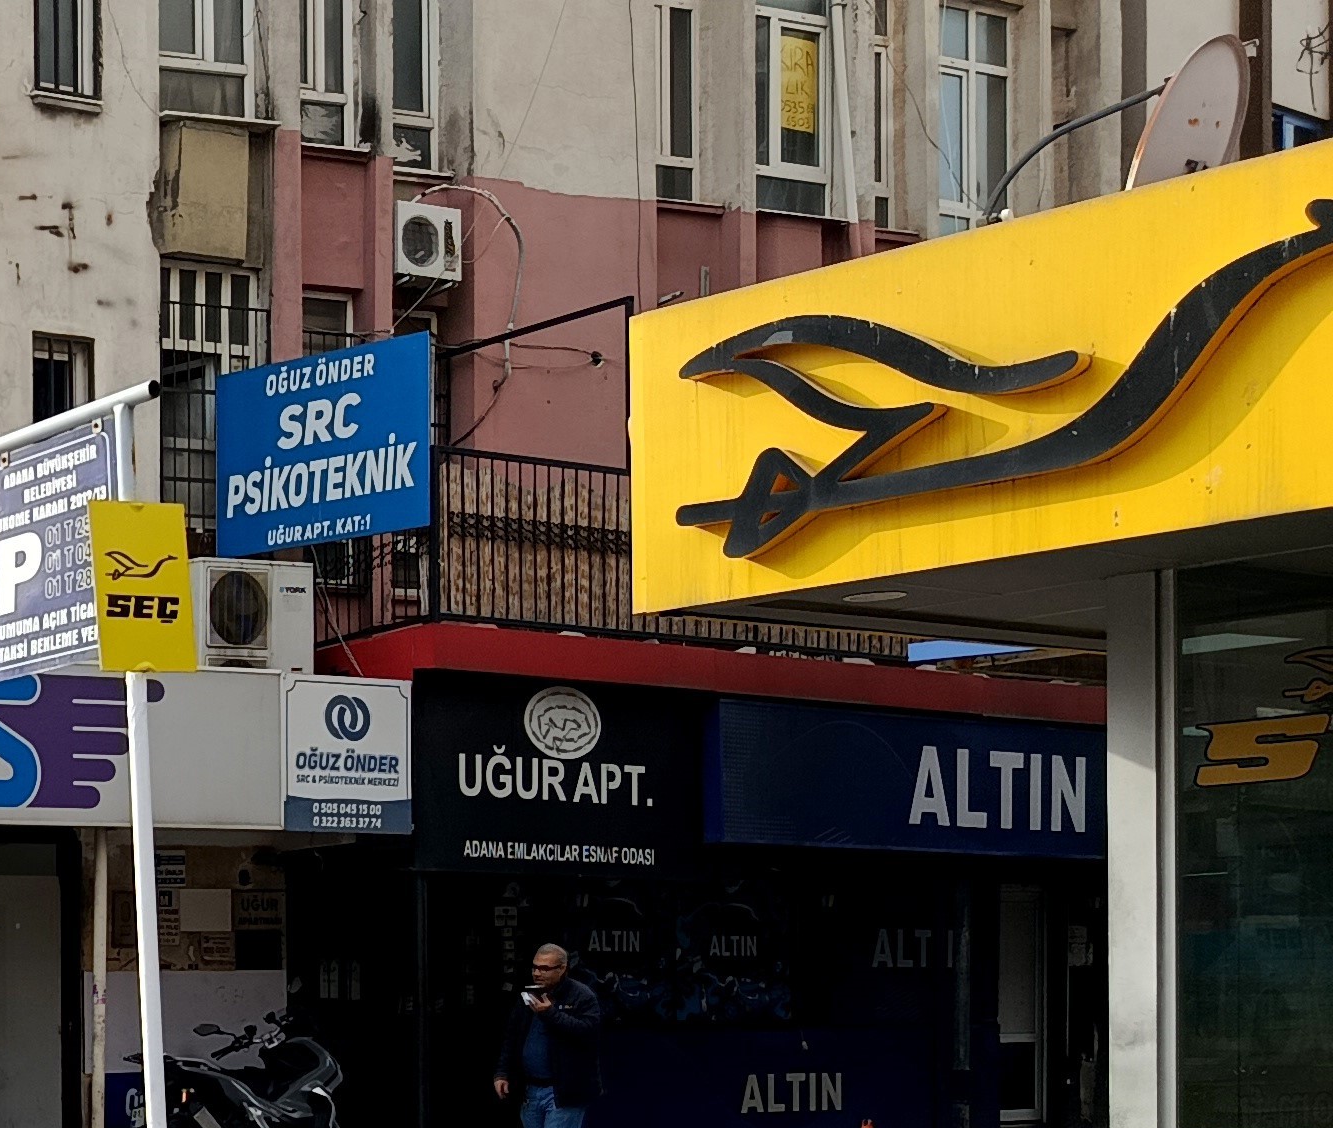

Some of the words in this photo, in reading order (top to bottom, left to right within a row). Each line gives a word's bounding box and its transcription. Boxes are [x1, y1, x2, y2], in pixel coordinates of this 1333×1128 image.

[265, 366, 312, 397] OĞUZ
[315, 353, 375, 386] ÖNDER
[277, 392, 361, 450] SRC
[3, 466, 35, 490] ADANA
[37, 444, 97, 479] BÜYÜKŞEHİR
[226, 432, 417, 519] PSİKOTEKNİK
[23, 470, 77, 504] BELEDİYESİ
[33, 498, 68, 522] KARARI
[44, 523, 61, 547] 01
[64, 519, 74, 541] T
[267, 524, 302, 545] UĞUR
[303, 520, 333, 541] APT.
[336, 514, 371, 535] KAT:1
[44, 549, 61, 573] 01
[64, 545, 74, 568] T
[44, 575, 61, 599] 01
[64, 571, 74, 594] T
[0, 616, 40, 641] UMUMA
[43, 608, 68, 630] AÇIK
[70, 602, 94, 622] TİCA
[105, 593, 179, 623] SEÇ
[0, 638, 27, 664] TAKSİ
[31, 629, 78, 656] BEKLEME
[296, 747, 341, 771] OĞUZ
[344, 748, 399, 774] ÖNDER
[1193, 712, 1332, 788] S
[296, 775, 310, 783] SRC
[318, 773, 366, 786] PSİKOTEKNİK
[367, 776, 399, 787] MERKEZİ
[458, 744, 567, 802] UĞUR
[572, 761, 654, 807] APT.
[908, 745, 1087, 833] ALTIN
[313, 803, 319, 813] 0
[321, 803, 338, 814] 505
[339, 803, 357, 814] 045
[358, 804, 368, 815] 15
[369, 805, 382, 815] 00
[313, 816, 319, 827] 0
[321, 817, 338, 827] 322
[339, 817, 357, 828] 363
[358, 818, 369, 828] 37
[370, 818, 381, 829] 74
[464, 839, 505, 859] ADANA
[507, 841, 580, 862] EMLAKCILAR
[582, 845, 619, 864] ESNAF
[621, 847, 655, 866] ODASI
[588, 929, 640, 952] ALTIN
[709, 935, 758, 957] ALTIN
[872, 928, 954, 968] ALTI
[741, 1072, 842, 1114] ALTIN
